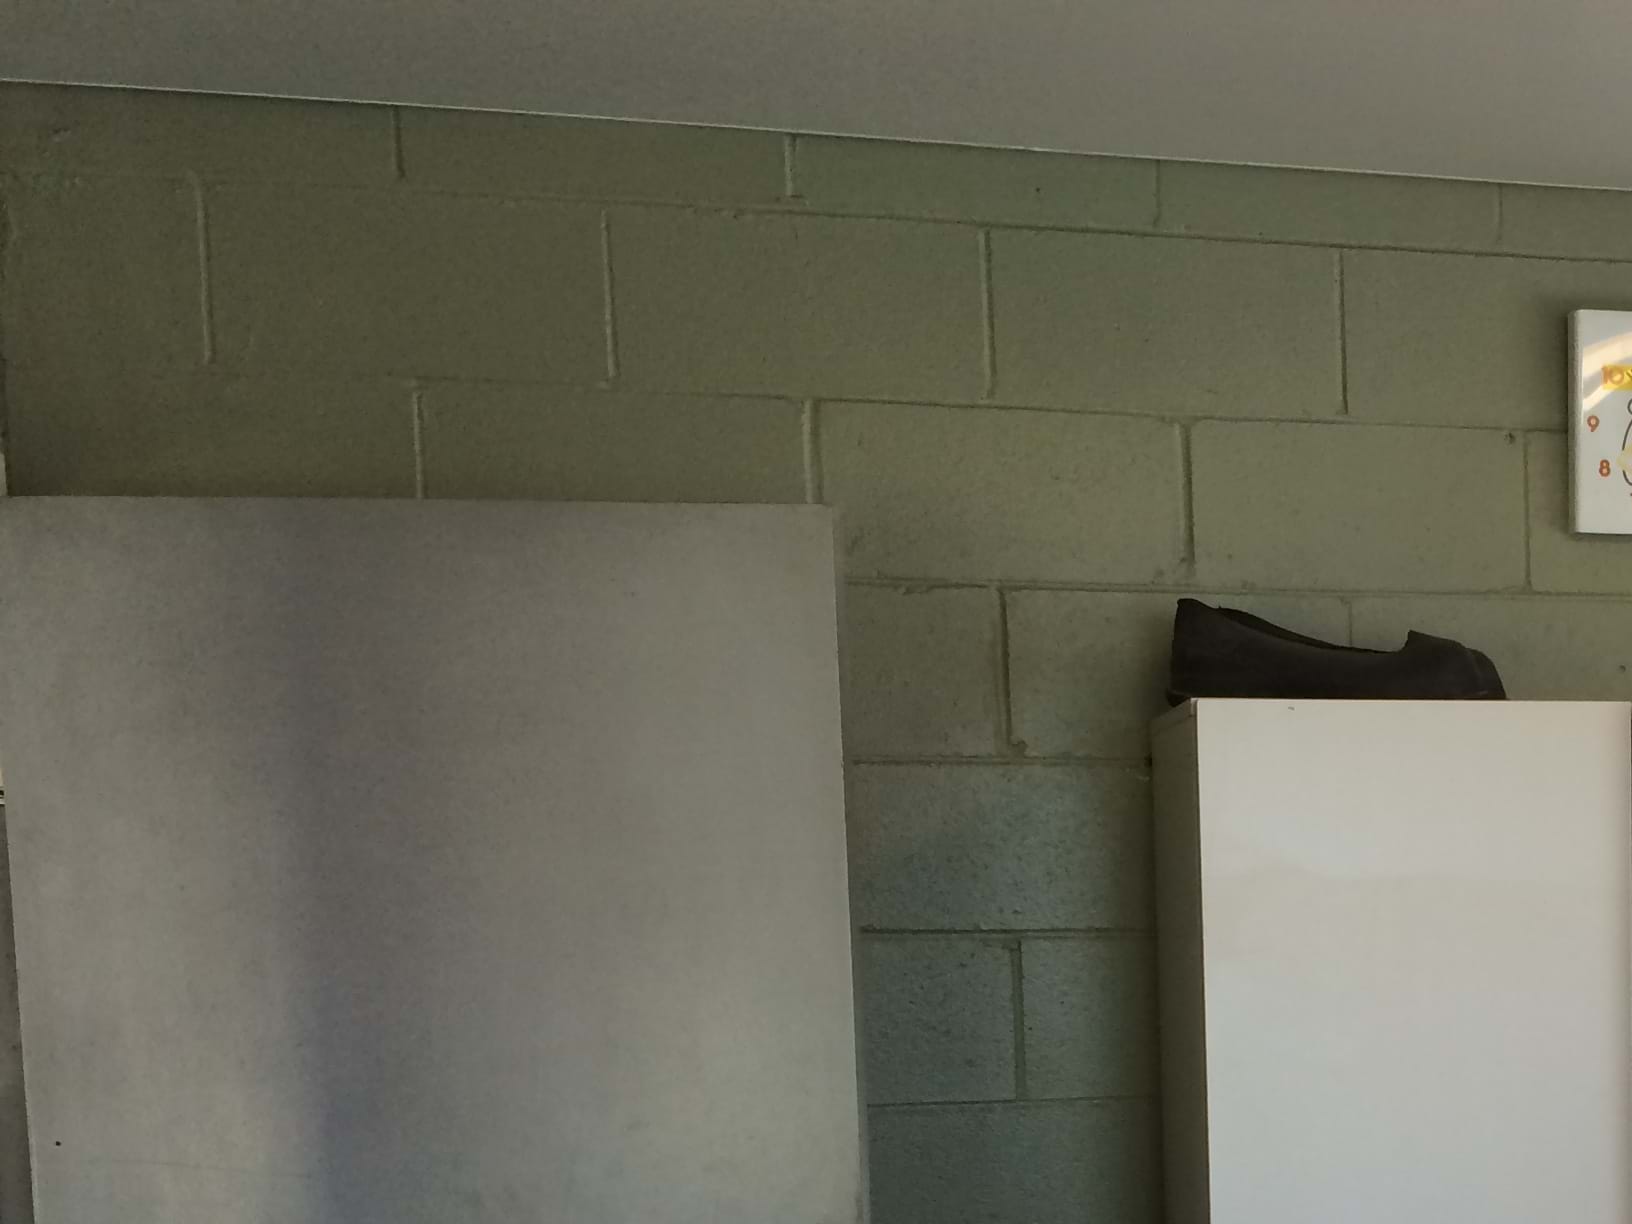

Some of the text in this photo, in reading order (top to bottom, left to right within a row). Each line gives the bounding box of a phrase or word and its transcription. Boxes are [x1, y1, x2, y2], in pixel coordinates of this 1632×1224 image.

[1602, 368, 1625, 385] 10
[1587, 415, 1600, 432] 9
[1599, 459, 1611, 477] 8
